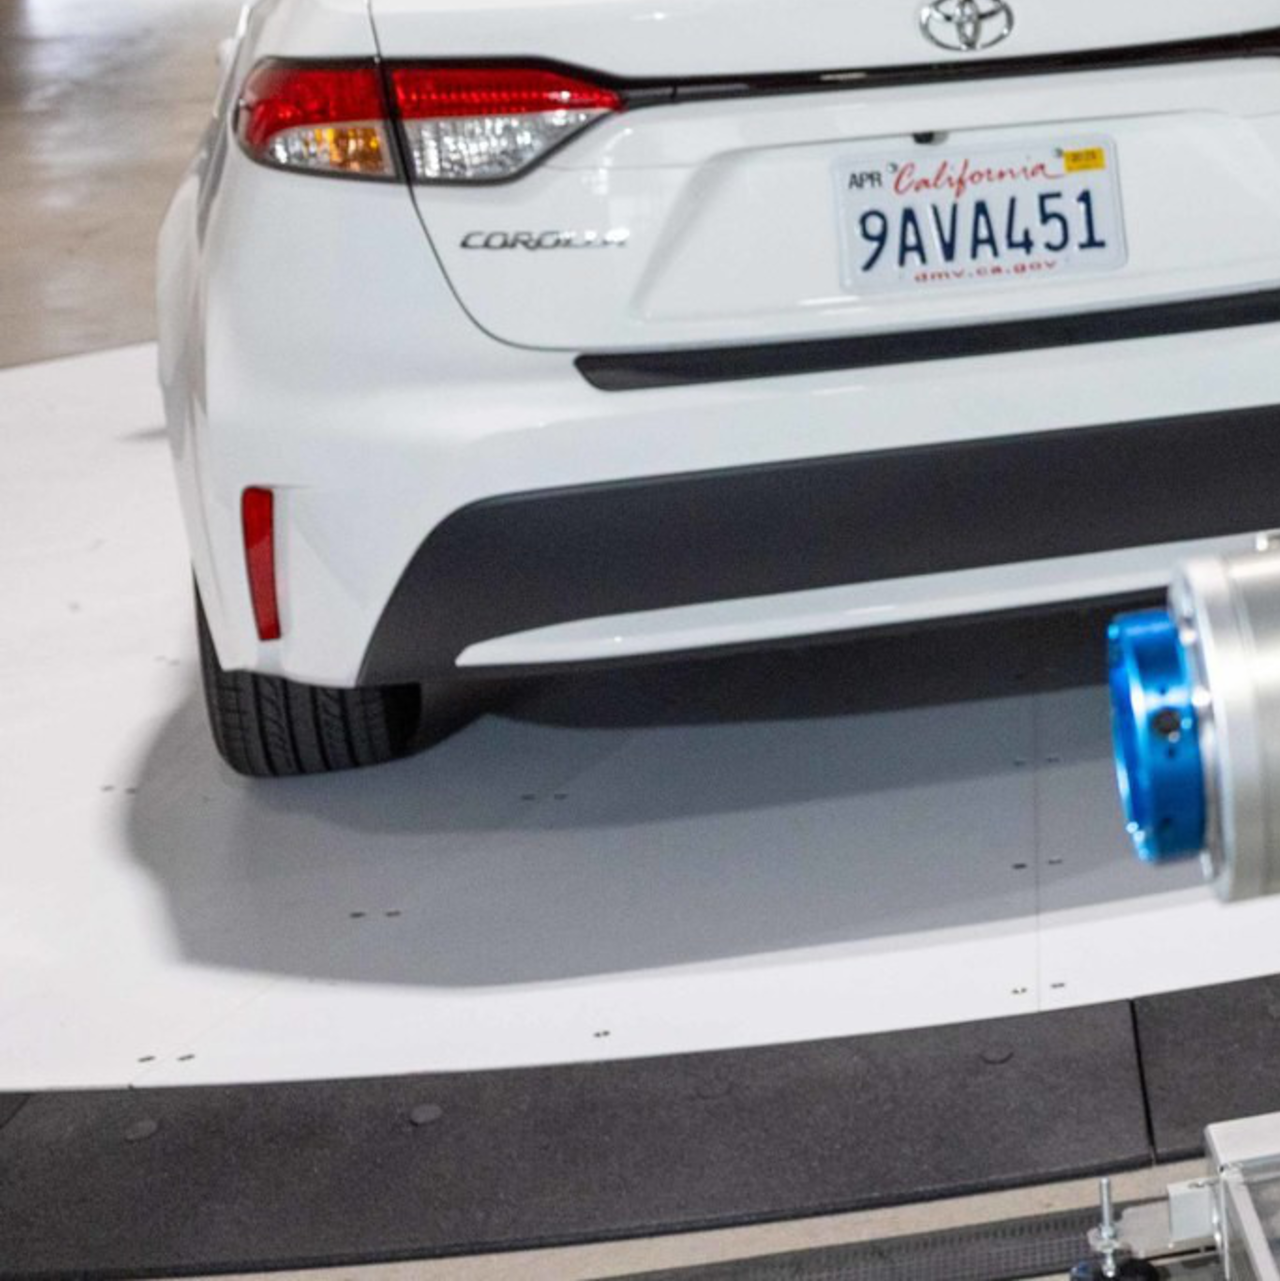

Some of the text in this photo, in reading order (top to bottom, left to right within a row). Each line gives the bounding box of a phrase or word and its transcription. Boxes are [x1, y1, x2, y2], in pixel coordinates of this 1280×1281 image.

[848, 172, 882, 190] APR
[894, 158, 1066, 199] California
[859, 189, 1106, 272] 9AVA451
[914, 260, 1057, 283] dmv.ca.gov
